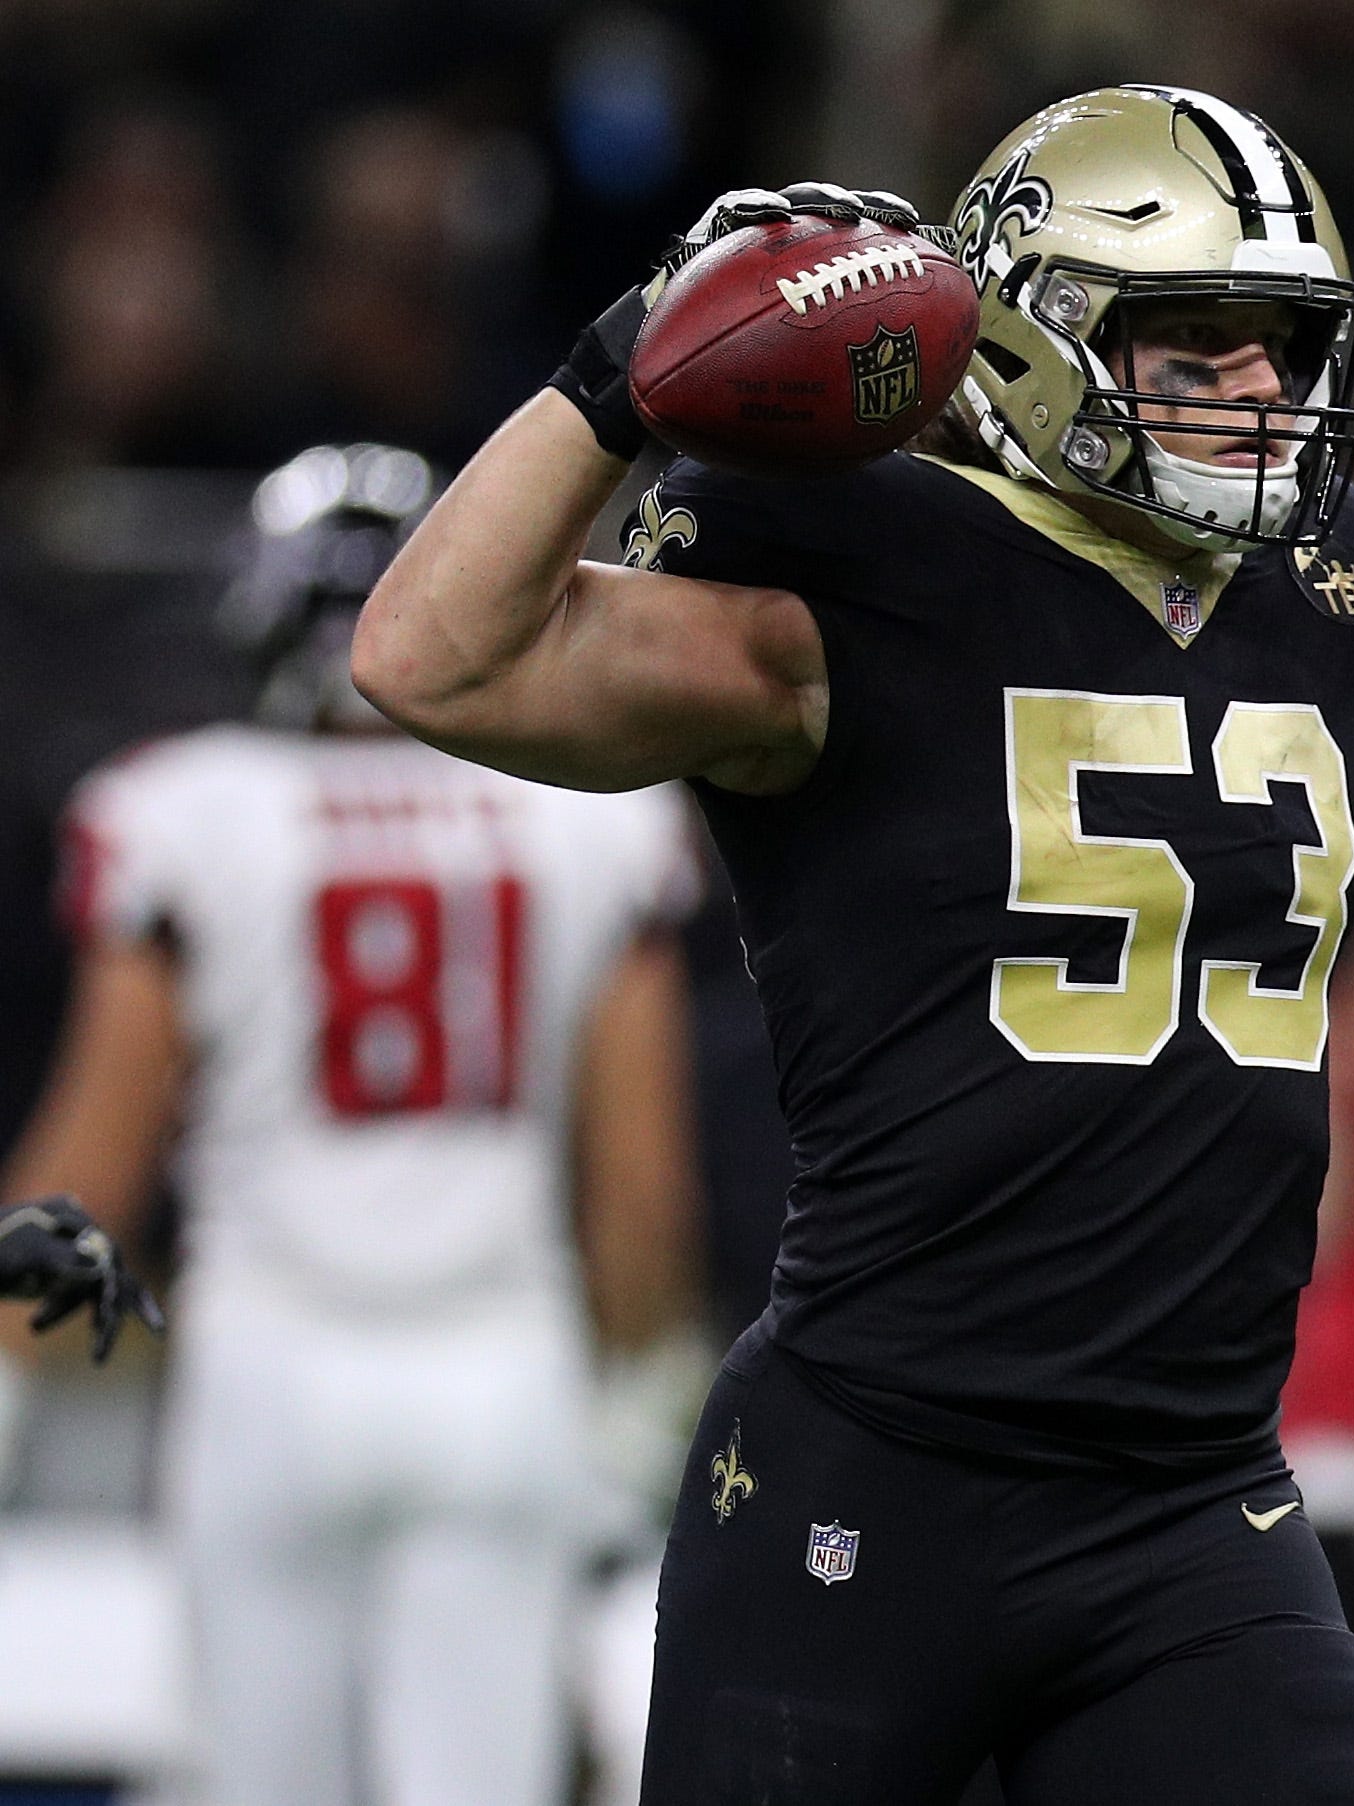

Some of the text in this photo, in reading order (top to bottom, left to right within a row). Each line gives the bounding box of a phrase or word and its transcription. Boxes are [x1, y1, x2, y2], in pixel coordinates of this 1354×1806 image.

[862, 366, 914, 415] NFL
[1168, 604, 1196, 627] NFL
[316, 874, 527, 1118] 81
[814, 1547, 847, 1573] NFL
